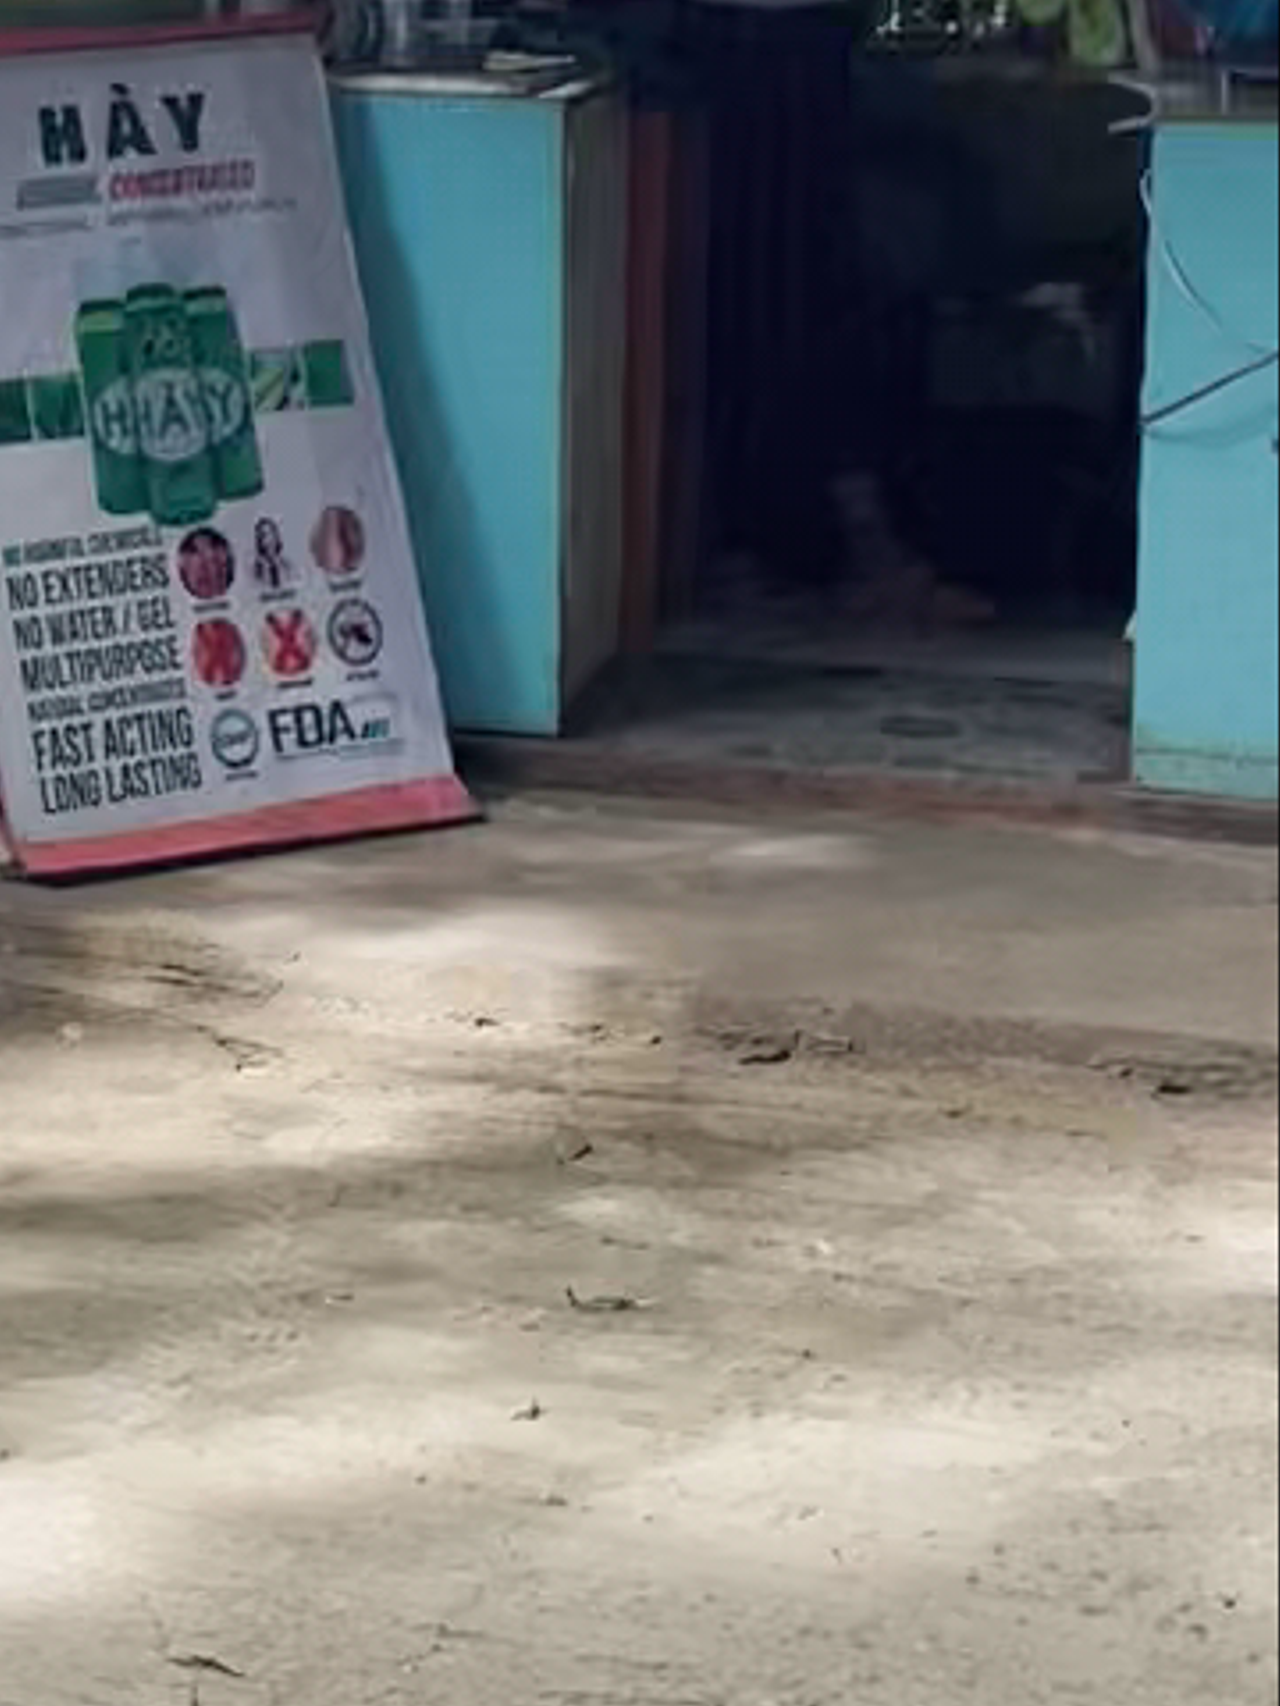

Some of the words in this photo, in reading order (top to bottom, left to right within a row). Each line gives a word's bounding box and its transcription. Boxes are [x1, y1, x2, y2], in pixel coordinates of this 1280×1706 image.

[38, 83, 205, 166] HÀY
[6, 571, 40, 611] NO
[42, 552, 171, 604] EXTENDERS
[13, 615, 44, 652] NO
[45, 606, 118, 646] WATER
[138, 596, 176, 632] GEL
[20, 634, 183, 691] MULTIPURPOSE
[33, 723, 96, 771] FAST
[104, 706, 195, 761] ACTING
[267, 699, 356, 754] FDA
[41, 769, 102, 815] LONG
[106, 751, 203, 804] LASTING
